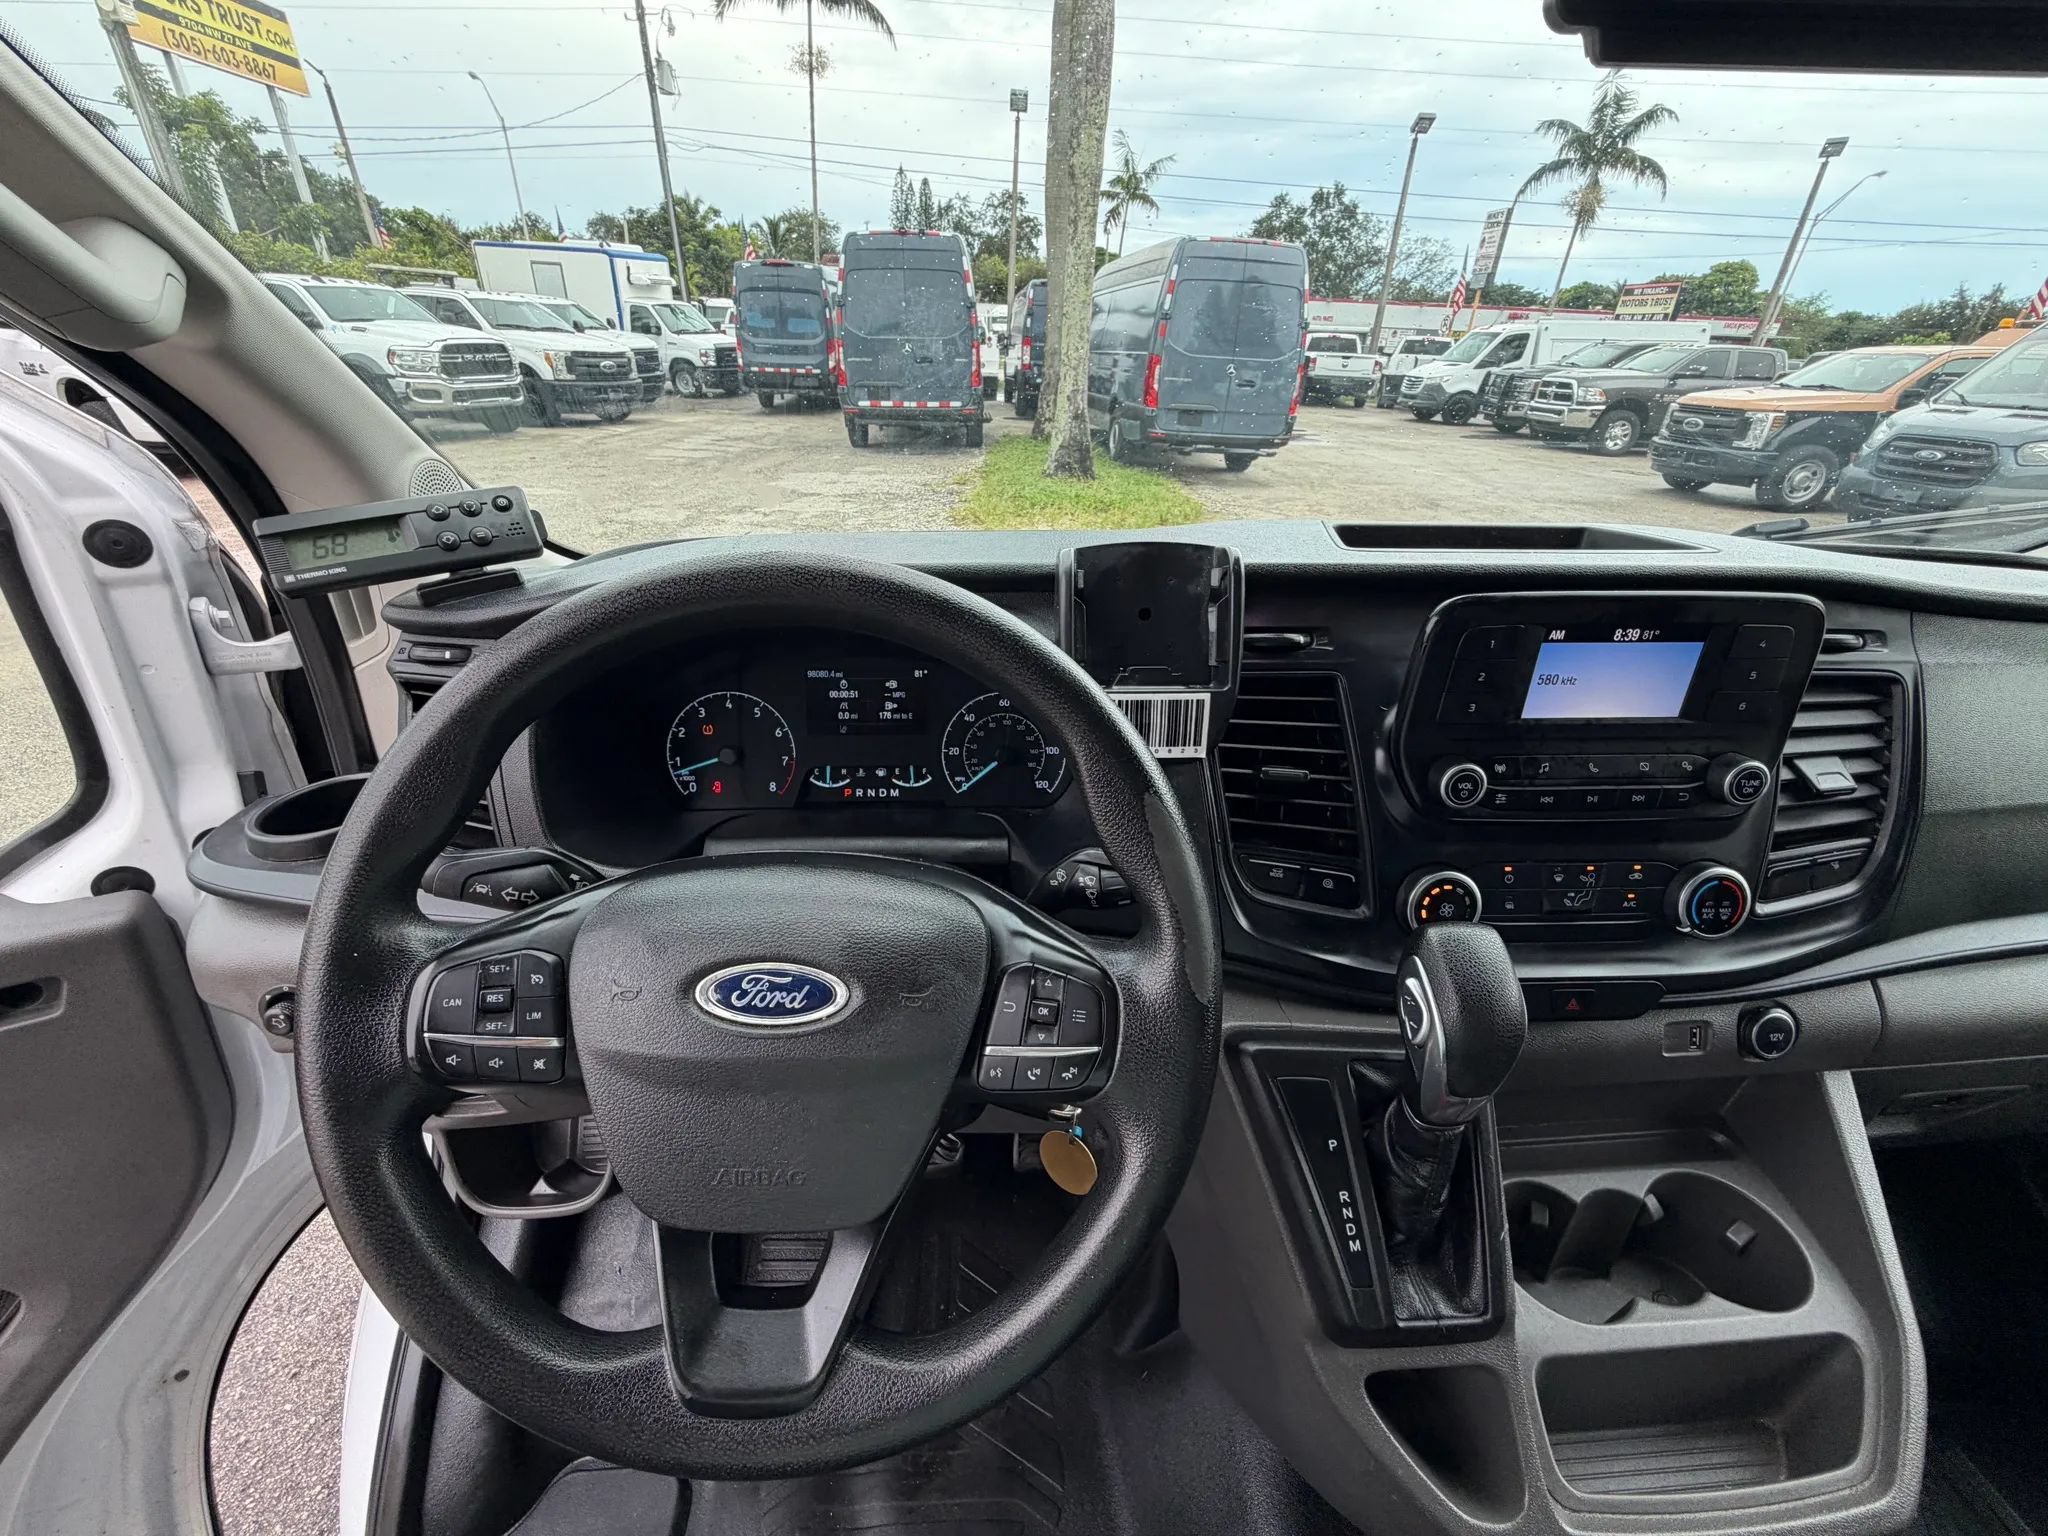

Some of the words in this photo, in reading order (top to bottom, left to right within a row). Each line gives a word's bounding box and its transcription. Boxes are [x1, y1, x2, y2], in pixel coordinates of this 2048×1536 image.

[178, 16, 205, 35] 9704
[205, 25, 222, 40] NW
[222, 32, 234, 44] 27
[235, 37, 254, 51] AVE
[161, 25, 278, 81] (305)-603-8867
[1619, 297, 1649, 308] MOTORS
[1650, 297, 1674, 307] TRUST
[312, 534, 348, 560] 68
[296, 570, 329, 580] THERMO
[328, 566, 348, 575] KING
[1549, 629, 1566, 640] AM
[1613, 628, 1641, 641] 8:39
[1642, 630, 1660, 640] 81°
[1490, 640, 1495, 648] 1
[1759, 640, 1767, 648] 4
[807, 670, 835, 678] 98080.4
[1477, 672, 1486, 681] 2
[1749, 671, 1757, 680] 5
[1537, 673, 1560, 686] 580
[1560, 675, 1578, 686] kHz
[829, 690, 859, 698] 00:00:51
[725, 699, 732, 709] 4
[998, 699, 1010, 707] 60
[1468, 703, 1476, 712] 3
[1738, 702, 1747, 711] 6
[698, 707, 706, 718] 3
[754, 707, 761, 717] 5
[838, 711, 850, 720] 0.0
[879, 711, 892, 719] 176
[964, 713, 975, 721] 40
[678, 727, 686, 738] 2
[775, 727, 783, 737] 6
[948, 747, 960, 755] 20
[1045, 746, 1060, 755] 100
[675, 756, 681, 767] 1
[781, 756, 788, 766] 7
[689, 782, 697, 792] 0
[769, 781, 777, 792] 8
[1035, 780, 1049, 789] 120
[1457, 782, 1473, 790] VOL
[1740, 779, 1761, 787] TUNE
[844, 788, 852, 797] P
[856, 788, 863, 797] R
[867, 788, 875, 797] N
[879, 788, 887, 797] D
[890, 788, 899, 797] M
[489, 964, 511, 973] SET+
[731, 974, 811, 1009] Ford
[442, 998, 462, 1007] CAN
[486, 994, 504, 1003] RES
[526, 1012, 542, 1020] LIM
[1038, 1007, 1049, 1016] OK
[485, 1022, 507, 1031] SET-
[1769, 1033, 1785, 1041] 12V
[1328, 1139, 1338, 1151] P
[712, 1168, 807, 1186] AIRBAG
[1338, 1190, 1351, 1203] R
[1342, 1206, 1354, 1220] N
[1345, 1223, 1356, 1236] D
[1348, 1239, 1362, 1252] M
